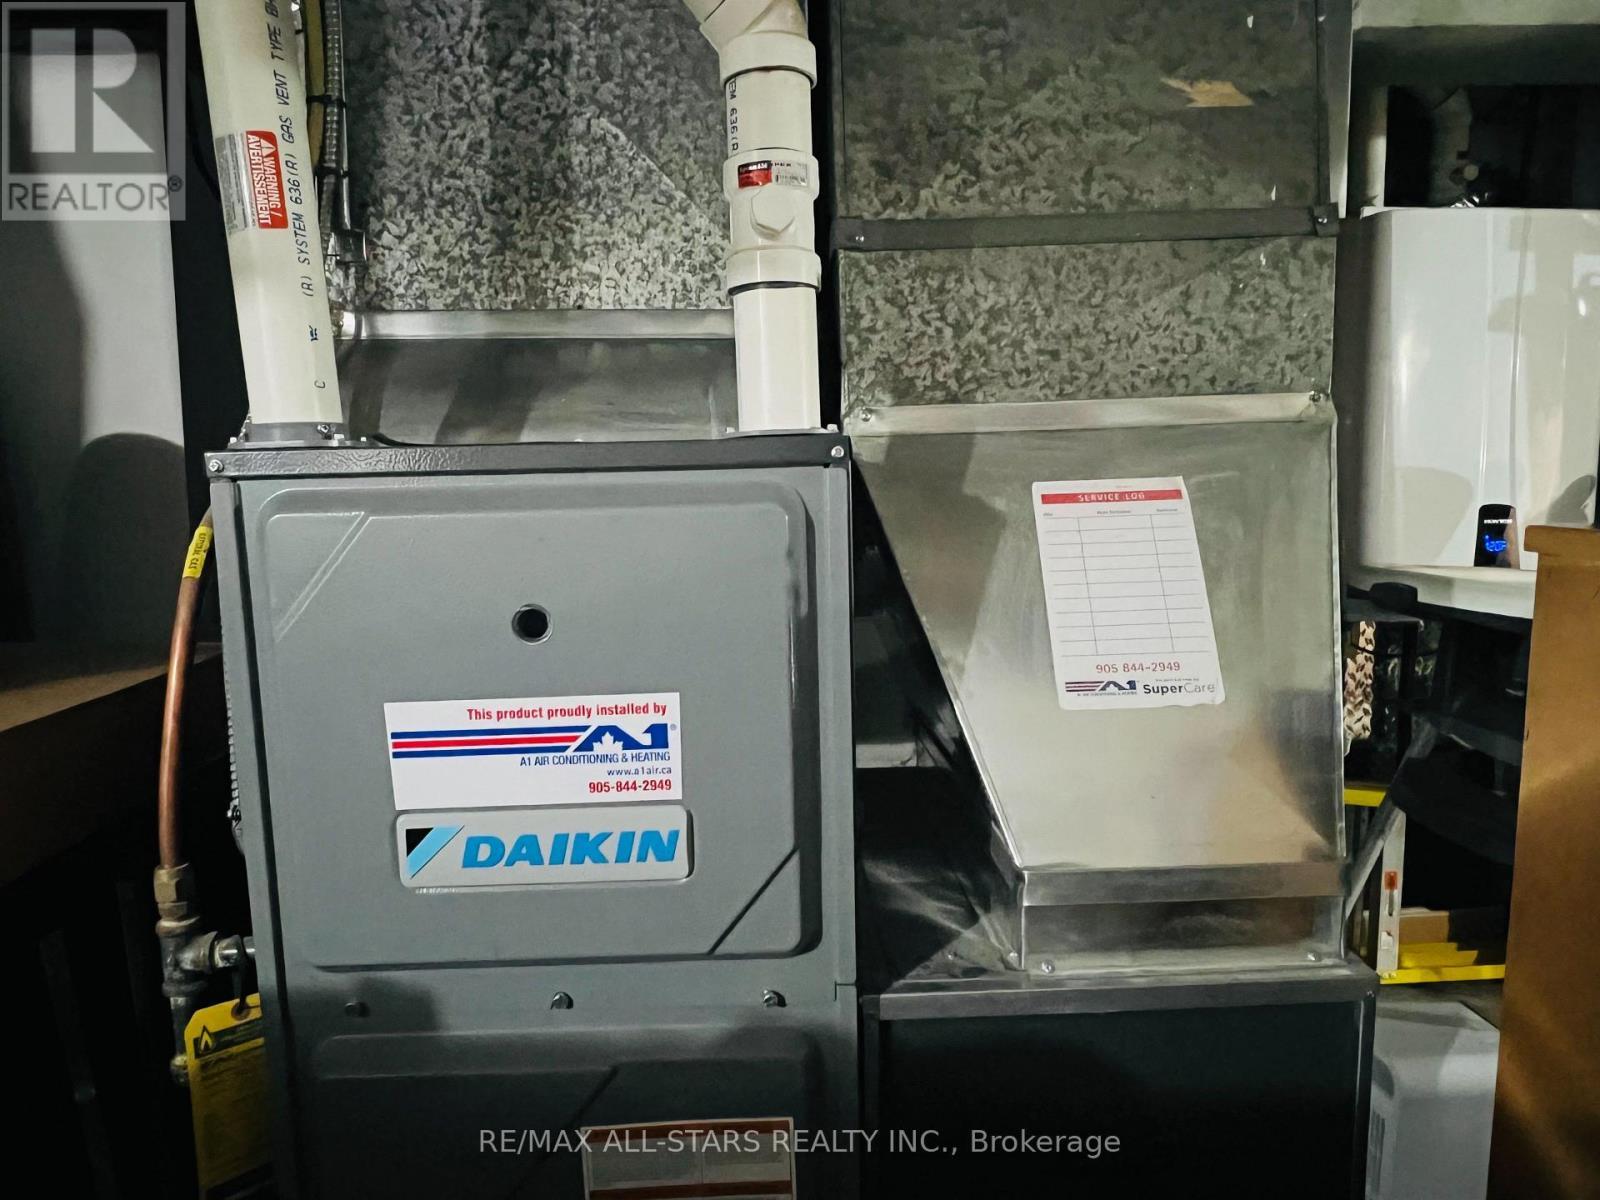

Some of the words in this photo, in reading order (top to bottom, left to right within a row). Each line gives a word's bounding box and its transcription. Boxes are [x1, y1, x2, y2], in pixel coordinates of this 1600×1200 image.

[267, 23, 285, 61] TYPE
[273, 69, 290, 106] VENT
[279, 115, 295, 144] GAS
[247, 134, 272, 225] AVERTISSEMENT
[263, 156, 282, 209] WARNING
[292, 211, 311, 266] SYSTEM
[1077, 492, 1120, 503] SERVICE
[1124, 491, 1146, 501] LOG
[1095, 663, 1119, 674] 905
[1122, 660, 1181, 674] 844-2949
[1142, 682, 1216, 696] SuperCare
[467, 708, 493, 721] This
[496, 706, 543, 722] product
[547, 704, 593, 720] proudly
[596, 702, 650, 717] installed
[653, 702, 667, 717] by
[519, 757, 532, 767] A1
[534, 756, 550, 767] AIR
[552, 753, 620, 766] CONDITIONING
[621, 752, 629, 763] &
[631, 751, 671, 763] HEATING
[606, 766, 673, 777] www.a1air.ca
[588, 778, 673, 794] 905-844-2949
[461, 828, 681, 869] DAIKIN
